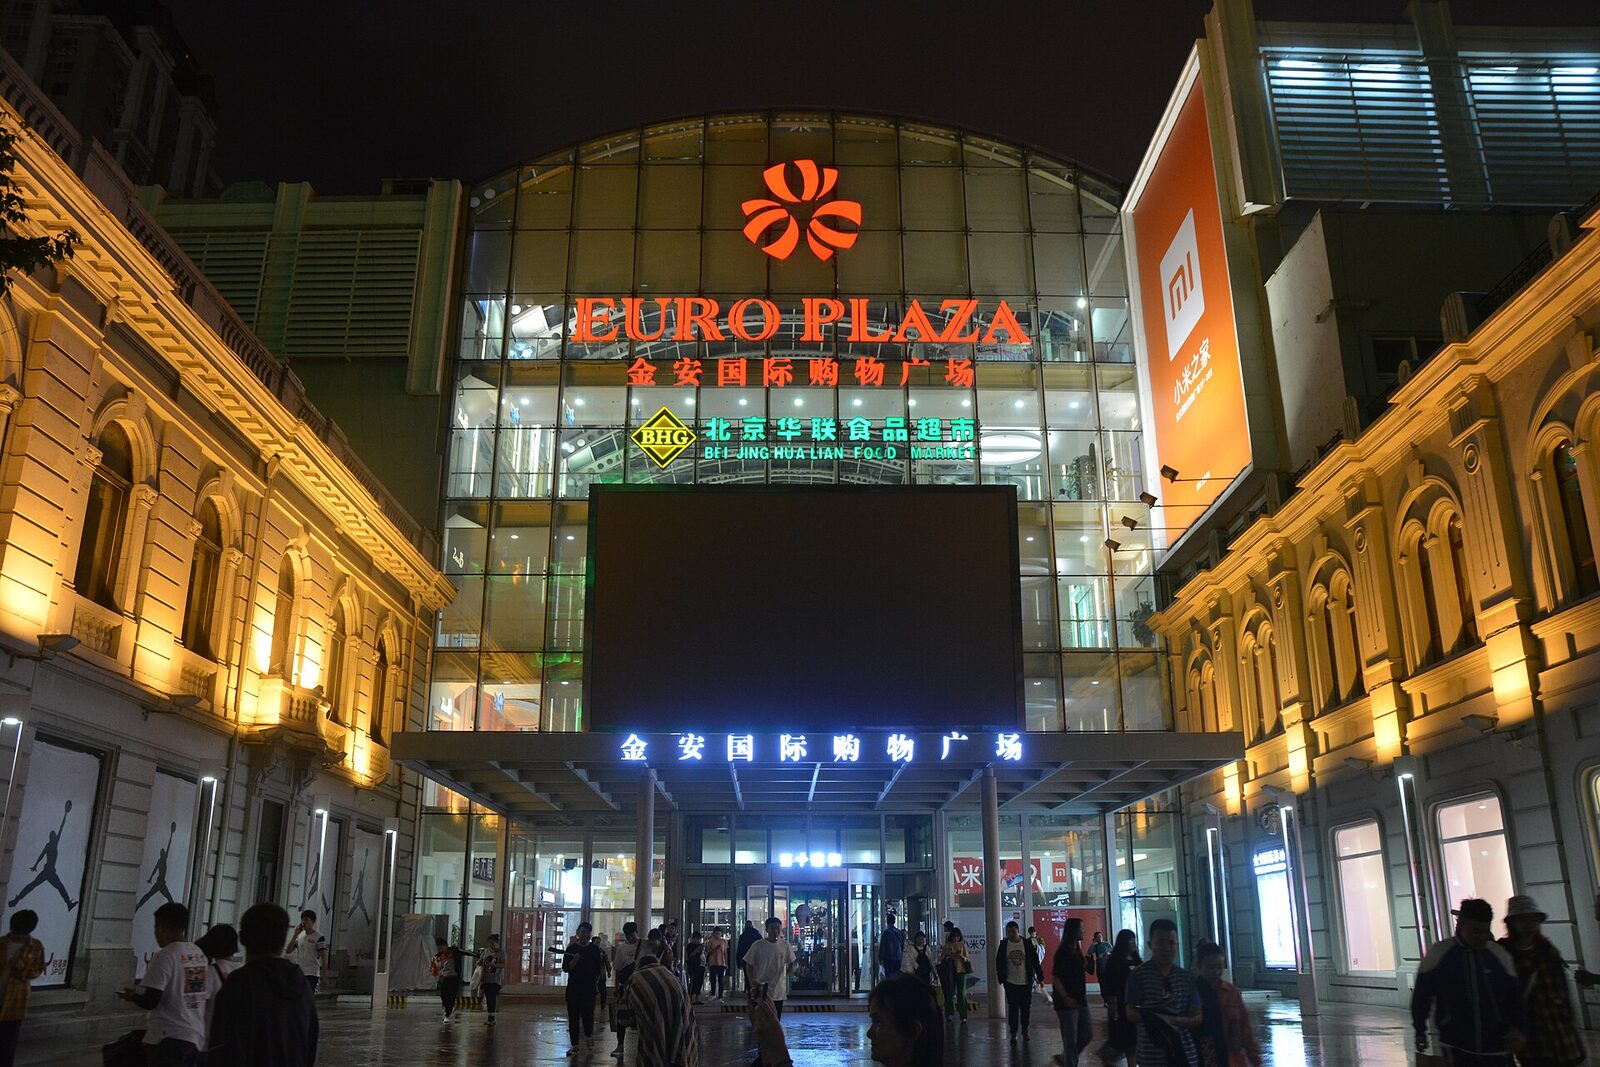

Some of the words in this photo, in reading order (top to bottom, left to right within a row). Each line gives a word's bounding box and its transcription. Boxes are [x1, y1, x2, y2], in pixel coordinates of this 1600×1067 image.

[571, 297, 781, 342] EURO
[800, 297, 1031, 343] PLAZA
[626, 356, 974, 388] 金安国际购物广场
[1173, 336, 1212, 406] 小米之家
[640, 429, 689, 446] BHG
[705, 415, 975, 442] 北京华联食品超市
[704, 446, 728, 460] BEI
[736, 446, 770, 460] JING
[773, 446, 805, 460] HUA
[810, 446, 844, 460] LIAN
[854, 446, 897, 460] FOOD
[910, 446, 976, 460] MARKET
[620, 731, 1023, 763] 金安国际购物广场
